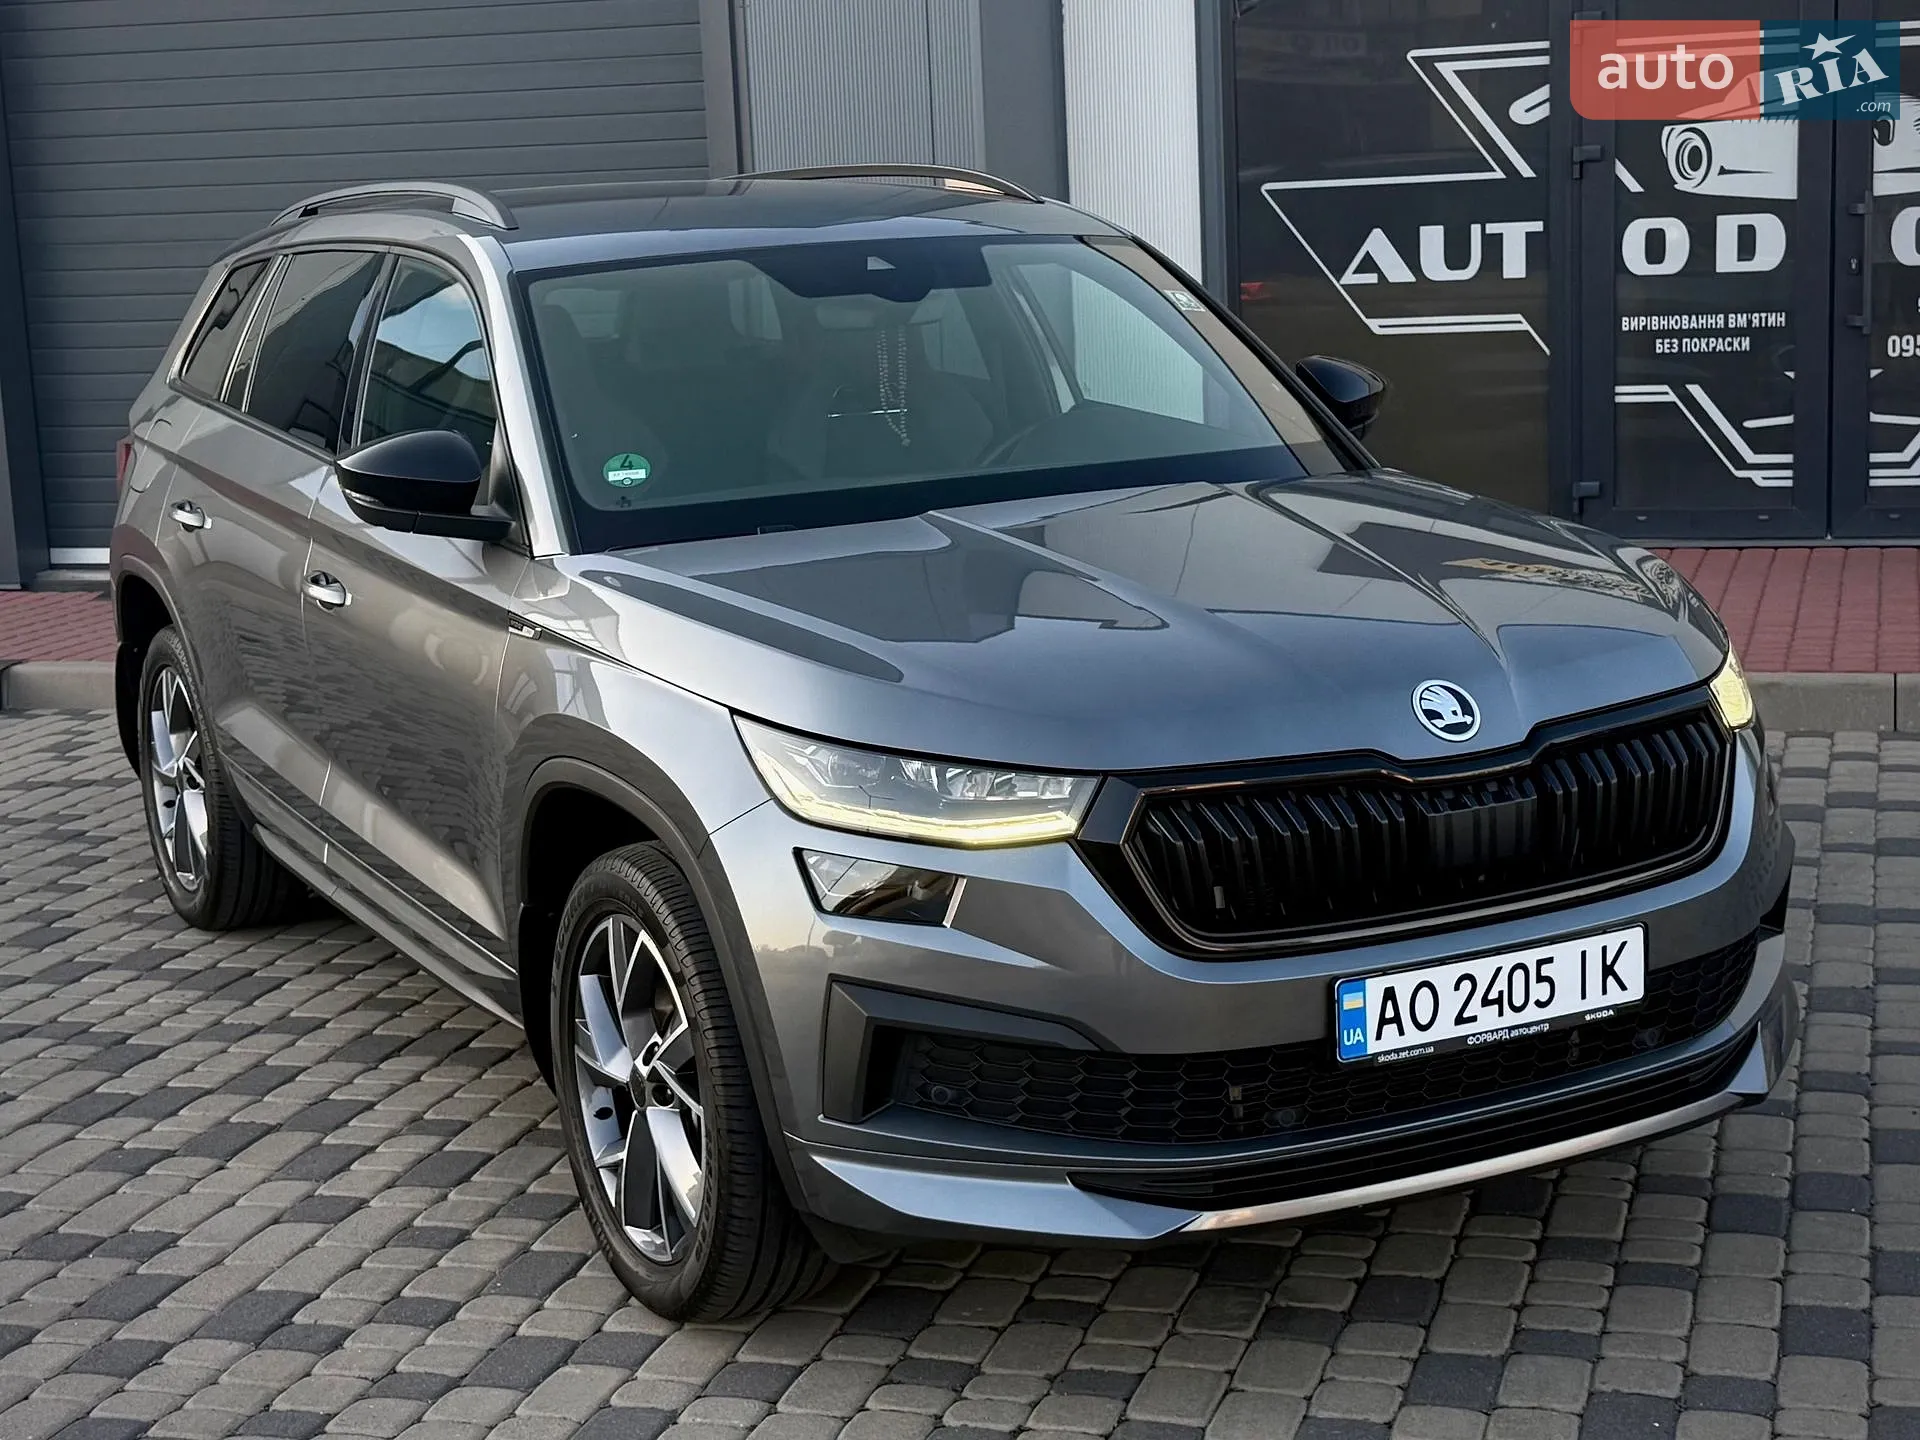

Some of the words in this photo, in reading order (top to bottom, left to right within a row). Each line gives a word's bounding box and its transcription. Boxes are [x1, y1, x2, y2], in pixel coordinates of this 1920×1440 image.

[1621, 313, 1725, 331] ВИРІВНЮВАННЯ
[1728, 312, 1786, 328] ВМ'ЯТИН
[1655, 338, 1679, 354] БЕЗ
[1682, 336, 1751, 353] ПОКРАСКИ
[1375, 980, 1440, 1041] AO
[1453, 956, 1556, 1026] 2405
[1343, 1028, 1364, 1045] UA
[1467, 1029, 1510, 1045] ФОРВАРД
